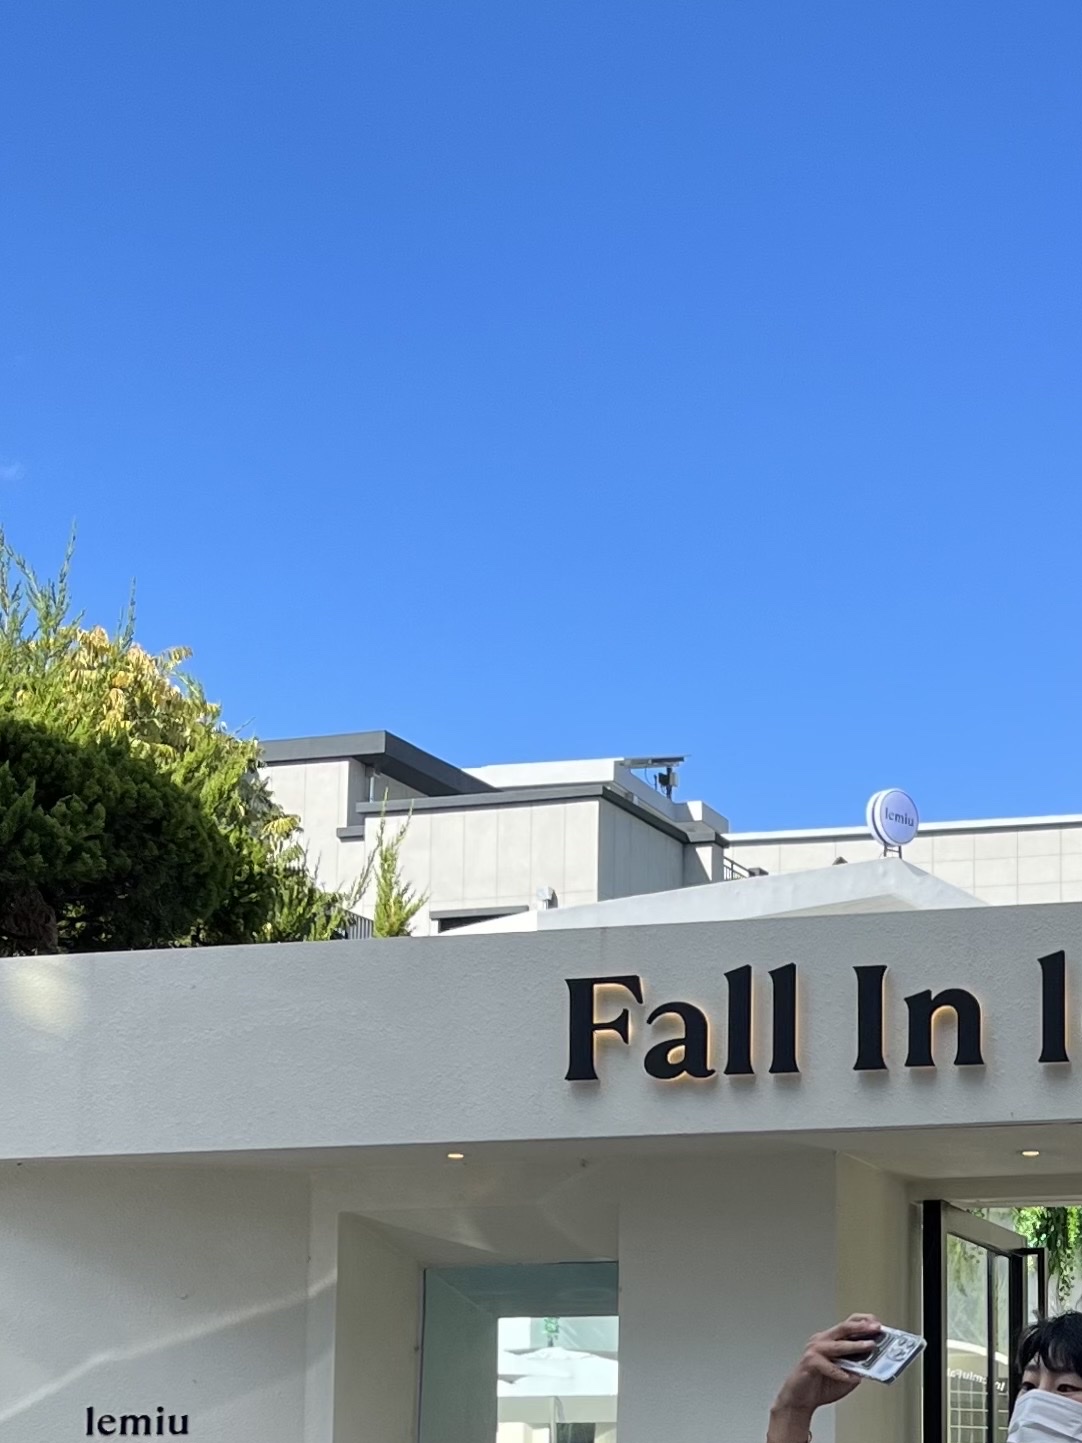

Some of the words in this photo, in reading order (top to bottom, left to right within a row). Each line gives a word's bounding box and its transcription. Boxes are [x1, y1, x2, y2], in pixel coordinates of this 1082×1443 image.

[885, 807, 914, 827] lemiu
[564, 961, 800, 1082] Fall
[852, 964, 985, 1072] In
[85, 1406, 189, 1437] lemiu
